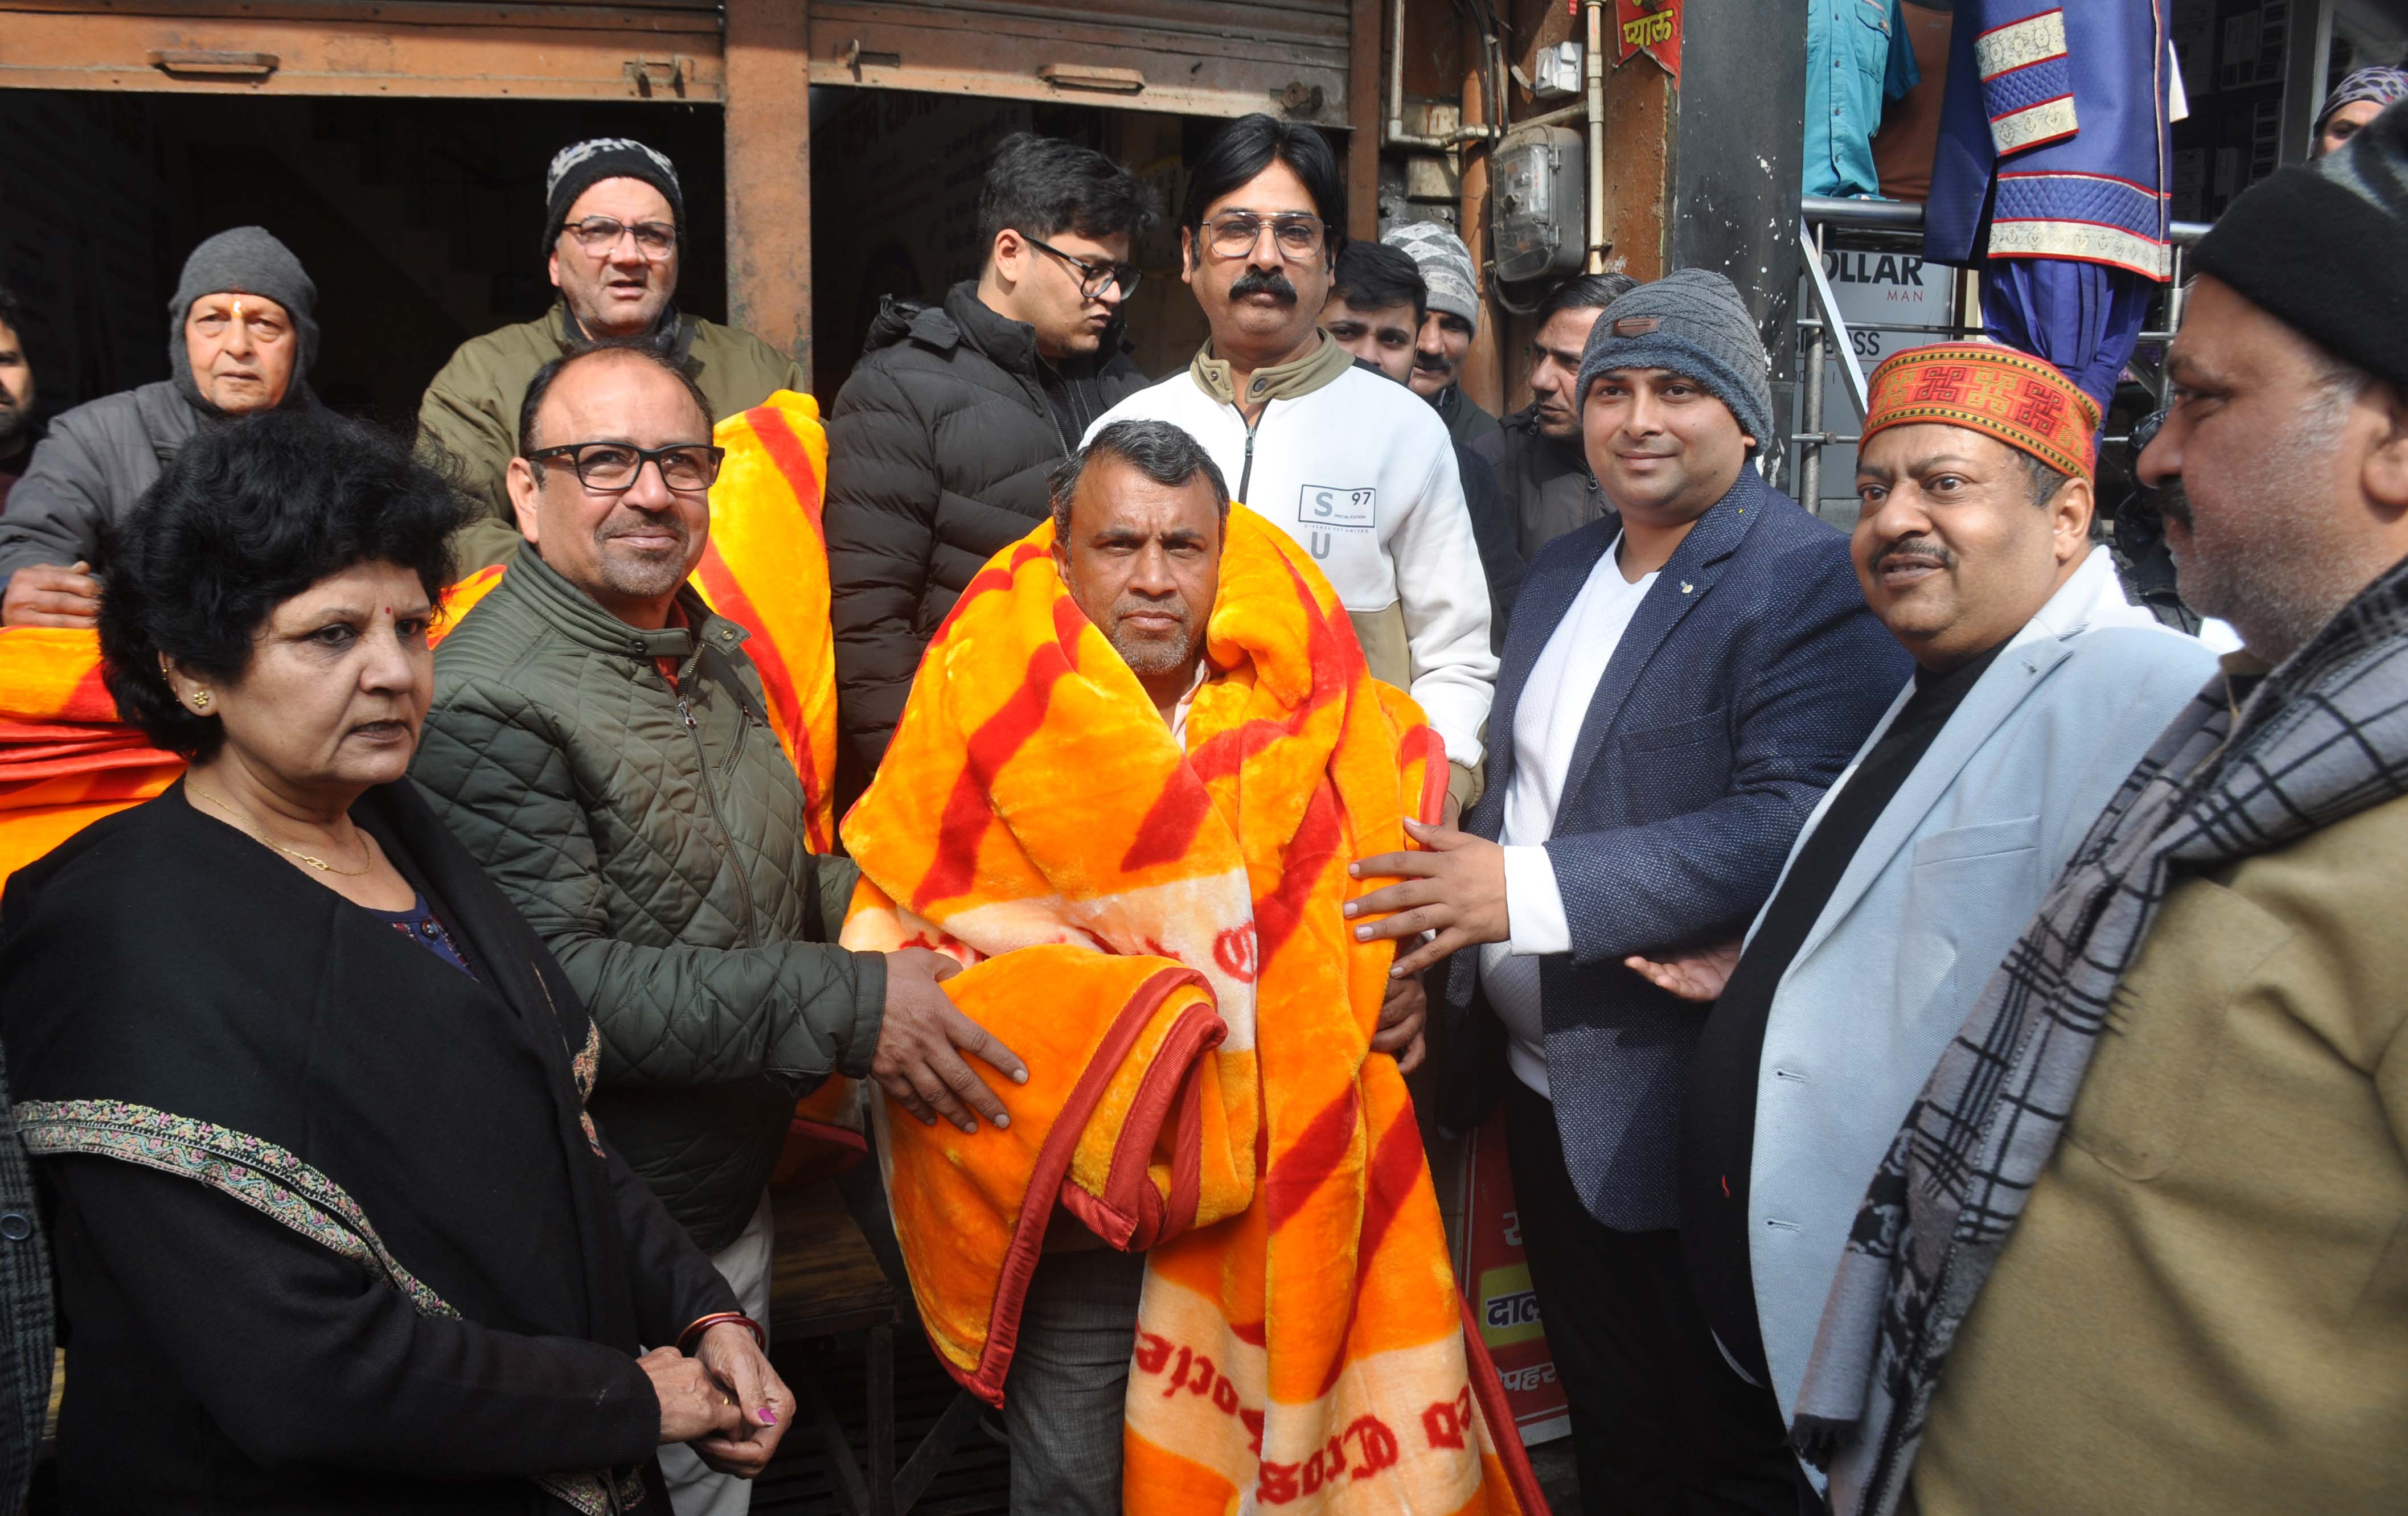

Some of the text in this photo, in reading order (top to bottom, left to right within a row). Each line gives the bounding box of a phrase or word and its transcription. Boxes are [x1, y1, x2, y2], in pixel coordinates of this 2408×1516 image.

[1623, 10, 1673, 48] प्याऊ
[1799, 252, 1923, 286] OLLAR
[1887, 289, 1923, 302] MAN
[1314, 491, 1333, 517] S
[1352, 492, 1371, 506] 97
[1311, 532, 1331, 559] U
